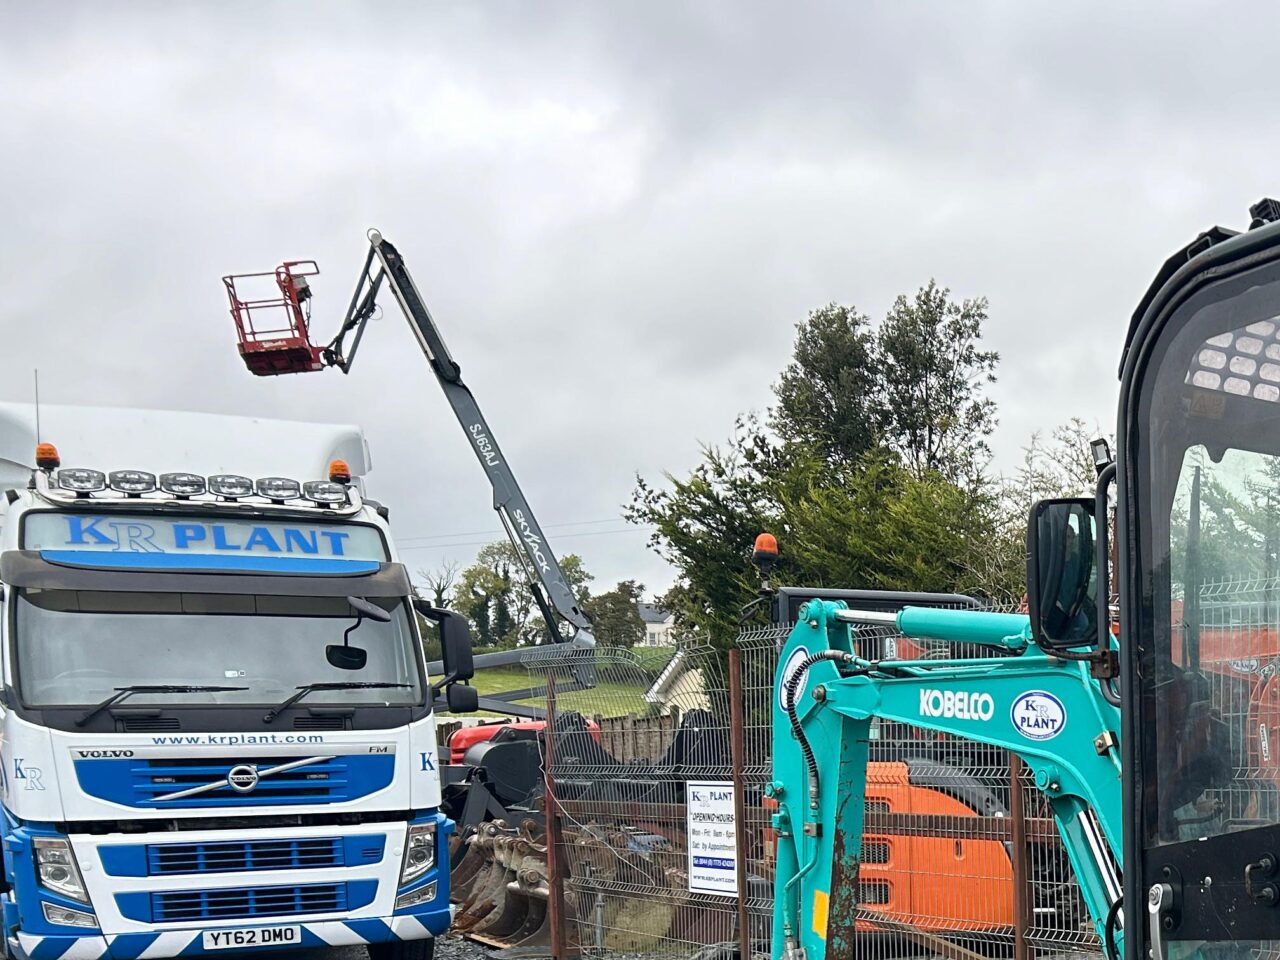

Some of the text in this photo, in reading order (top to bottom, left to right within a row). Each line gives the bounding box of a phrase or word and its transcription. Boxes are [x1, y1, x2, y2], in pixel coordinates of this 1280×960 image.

[469, 423, 500, 467] SJ63AJ
[65, 515, 349, 557] KR PLANT
[513, 508, 551, 575] SKYJACK
[920, 688, 995, 722] KOBELCO
[1020, 716, 1058, 730] PLANT
[152, 732, 324, 746] www.krplant.com
[77, 749, 134, 758] VOLVO
[709, 792, 733, 801] PLANT
[210, 927, 295, 946] YT62 DMO
